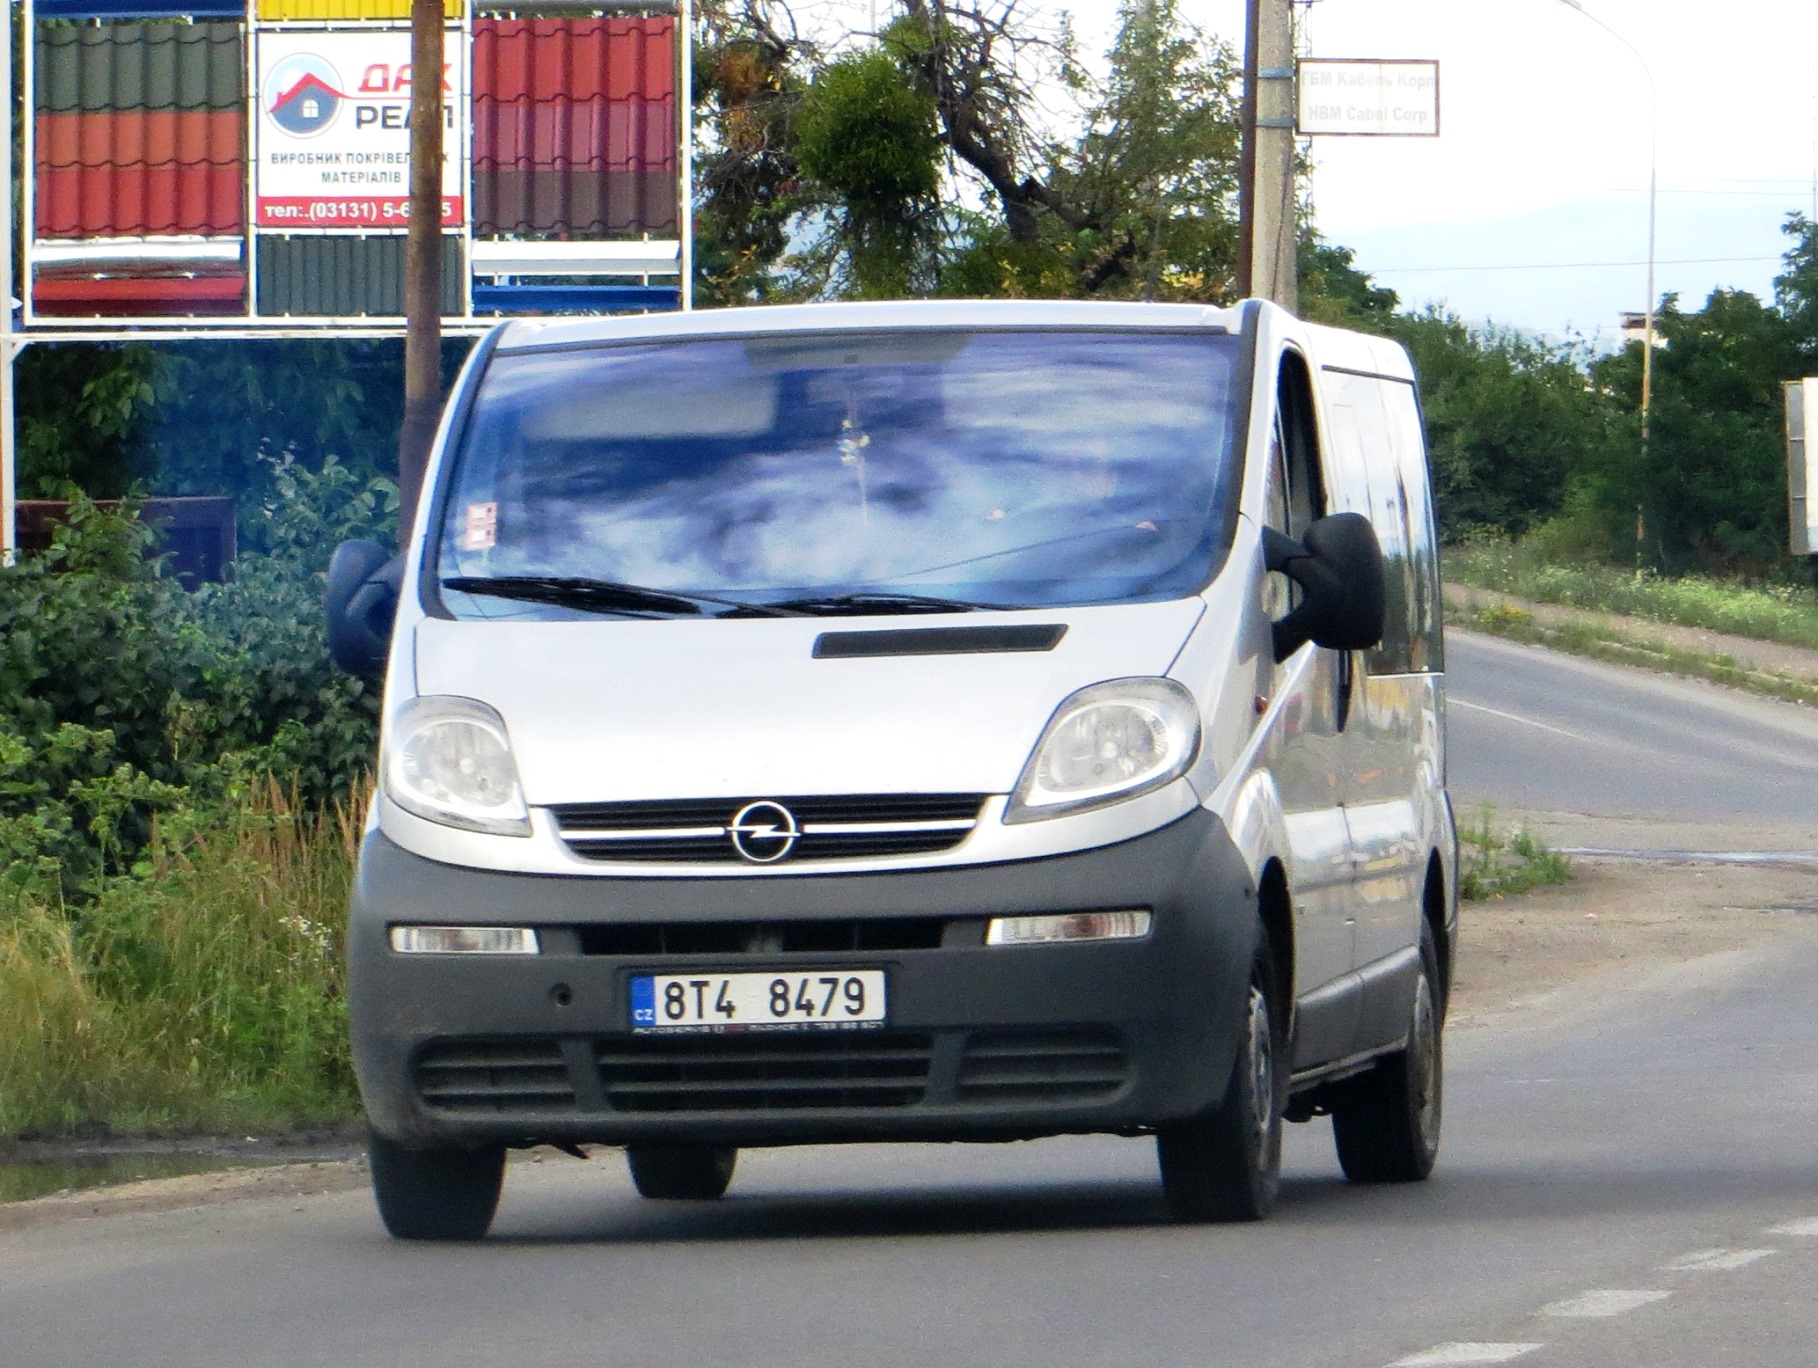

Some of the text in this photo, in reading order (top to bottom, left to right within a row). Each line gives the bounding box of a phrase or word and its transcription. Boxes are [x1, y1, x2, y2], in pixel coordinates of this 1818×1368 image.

[1308, 106, 1342, 121] HBM
[1393, 107, 1427, 125] Corp
[271, 153, 342, 165] ВИРОБНИК
[321, 172, 402, 183] МАТЕРІАЛІВ
[664, 977, 865, 1020] 8T4 8479
[634, 1009, 653, 1021] CZ
